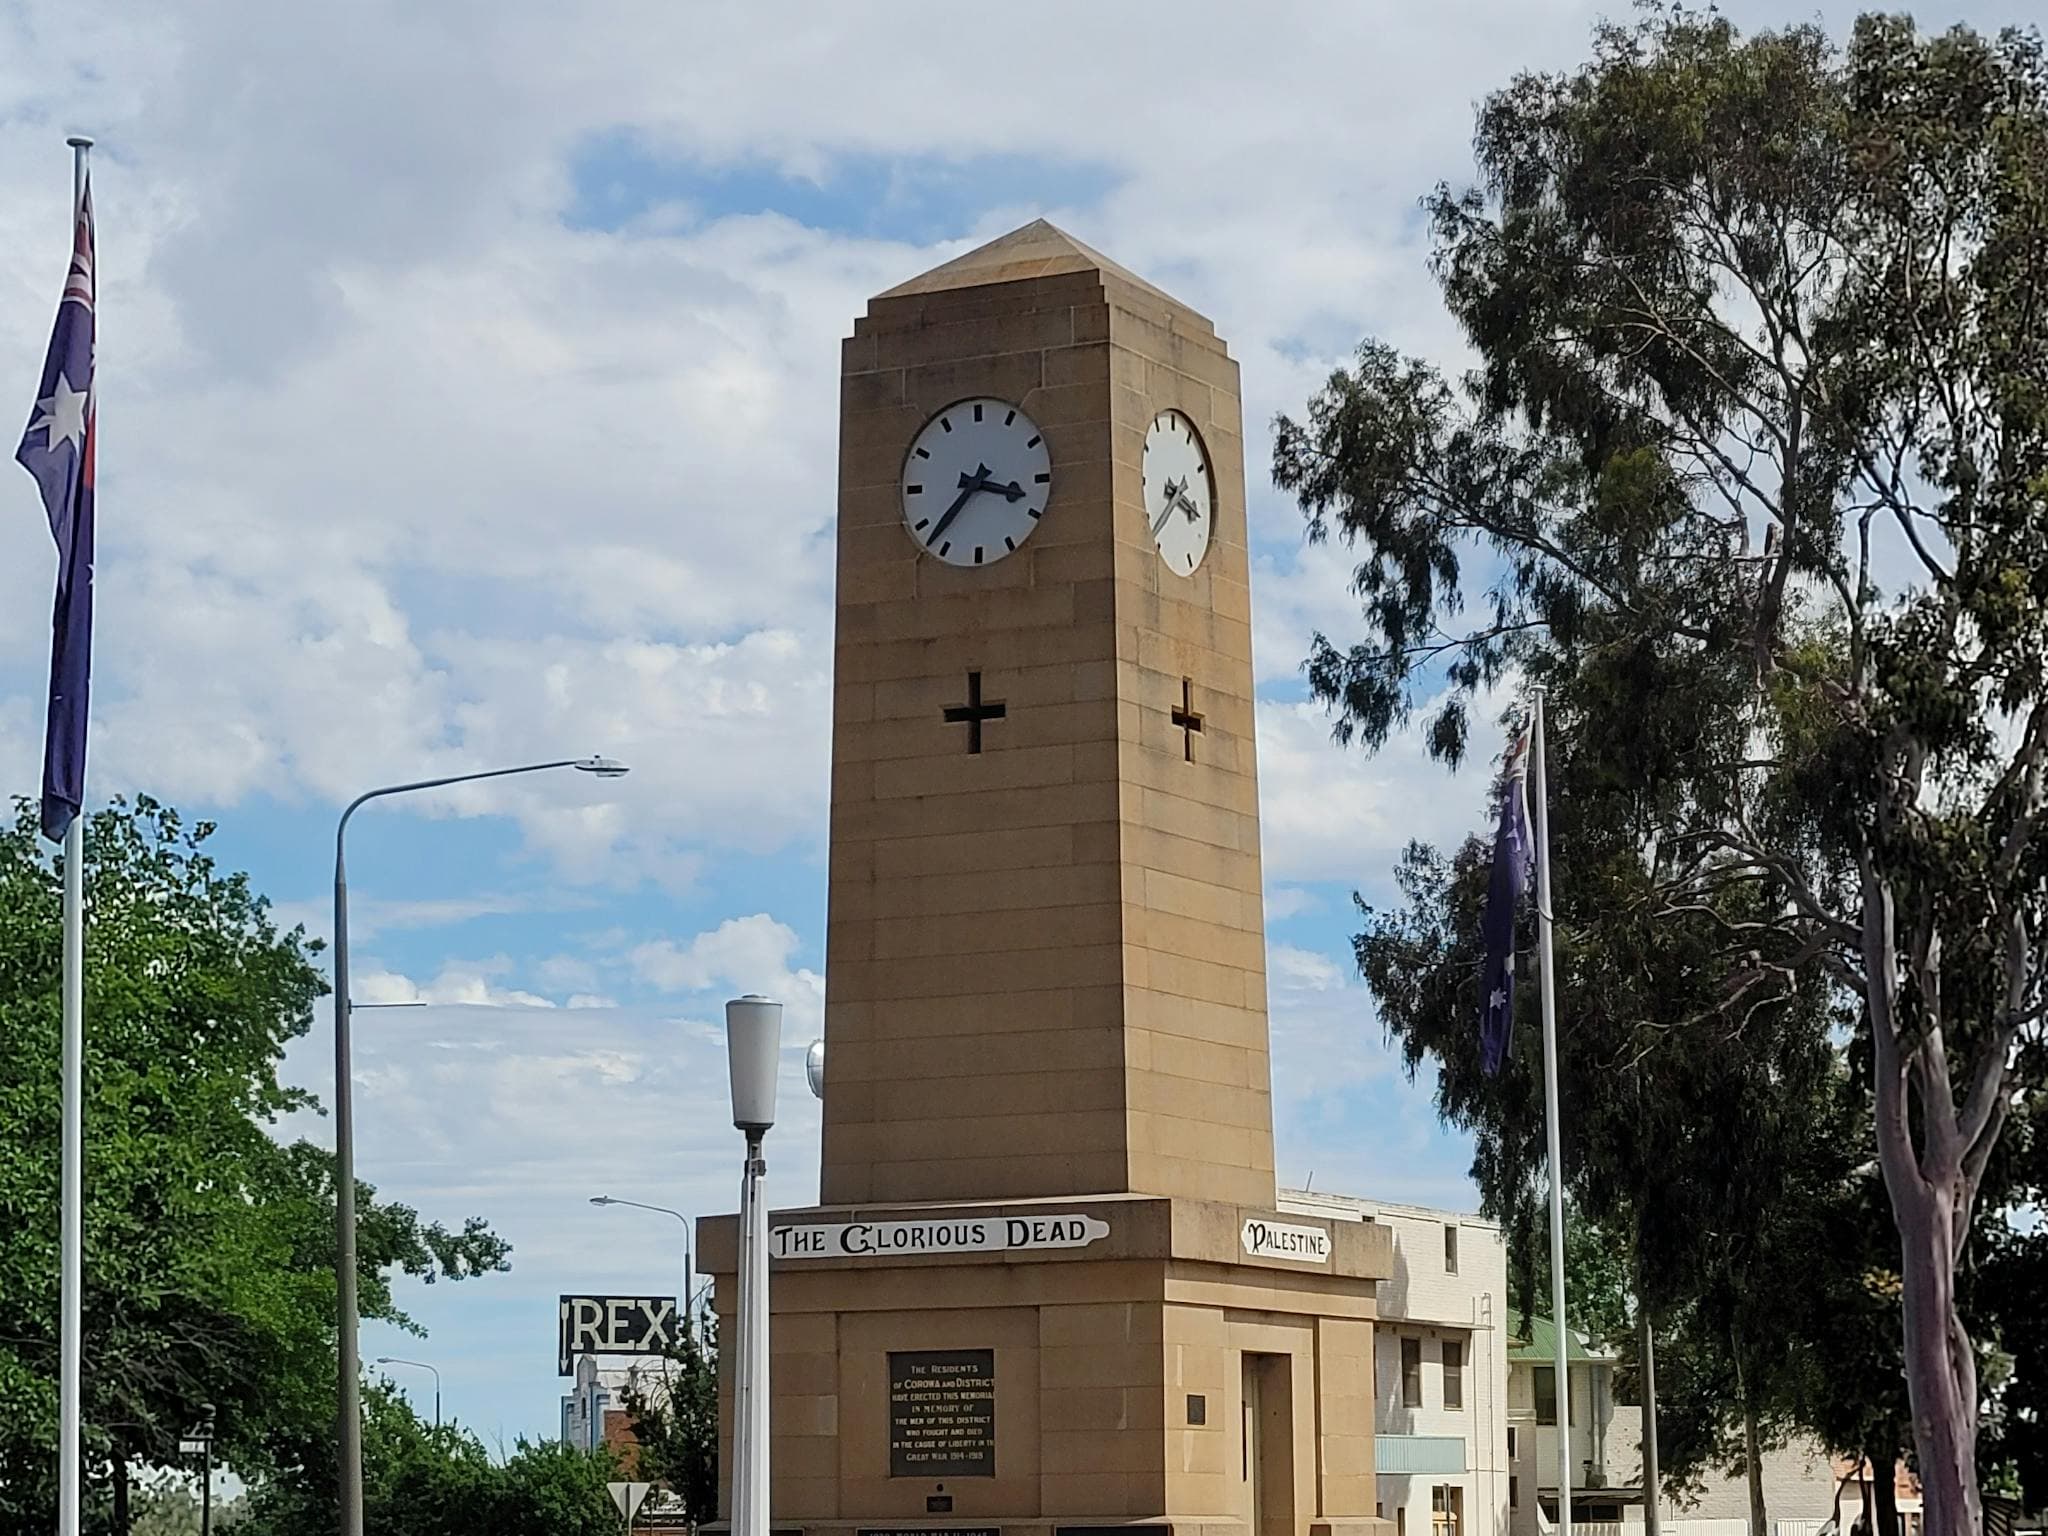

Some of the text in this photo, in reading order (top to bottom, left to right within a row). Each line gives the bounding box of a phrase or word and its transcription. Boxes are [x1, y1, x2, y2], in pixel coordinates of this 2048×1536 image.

[774, 1219, 1087, 1255] THE GLORIOUS DEAD
[1248, 1223, 1325, 1254] PALESTINE
[570, 1298, 675, 1350] REX
[911, 1364, 978, 1375] THE RESIDENTS
[904, 1379, 940, 1390] COROWA
[892, 1394, 909, 1402] HAVE
[910, 1392, 941, 1402] ERECTED
[942, 1392, 959, 1400] THIS
[912, 1404, 974, 1413] IN MEMORY OF
[910, 1417, 924, 1425] MEN
[926, 1417, 936, 1425] OF
[956, 1416, 991, 1424] DISTRICT
[950, 1428, 964, 1436] AND
[937, 1440, 946, 1448] OF
[948, 1440, 976, 1448] LIBERTY
[906, 1453, 929, 1461] GREAT
[931, 1452, 948, 1460] WAR
